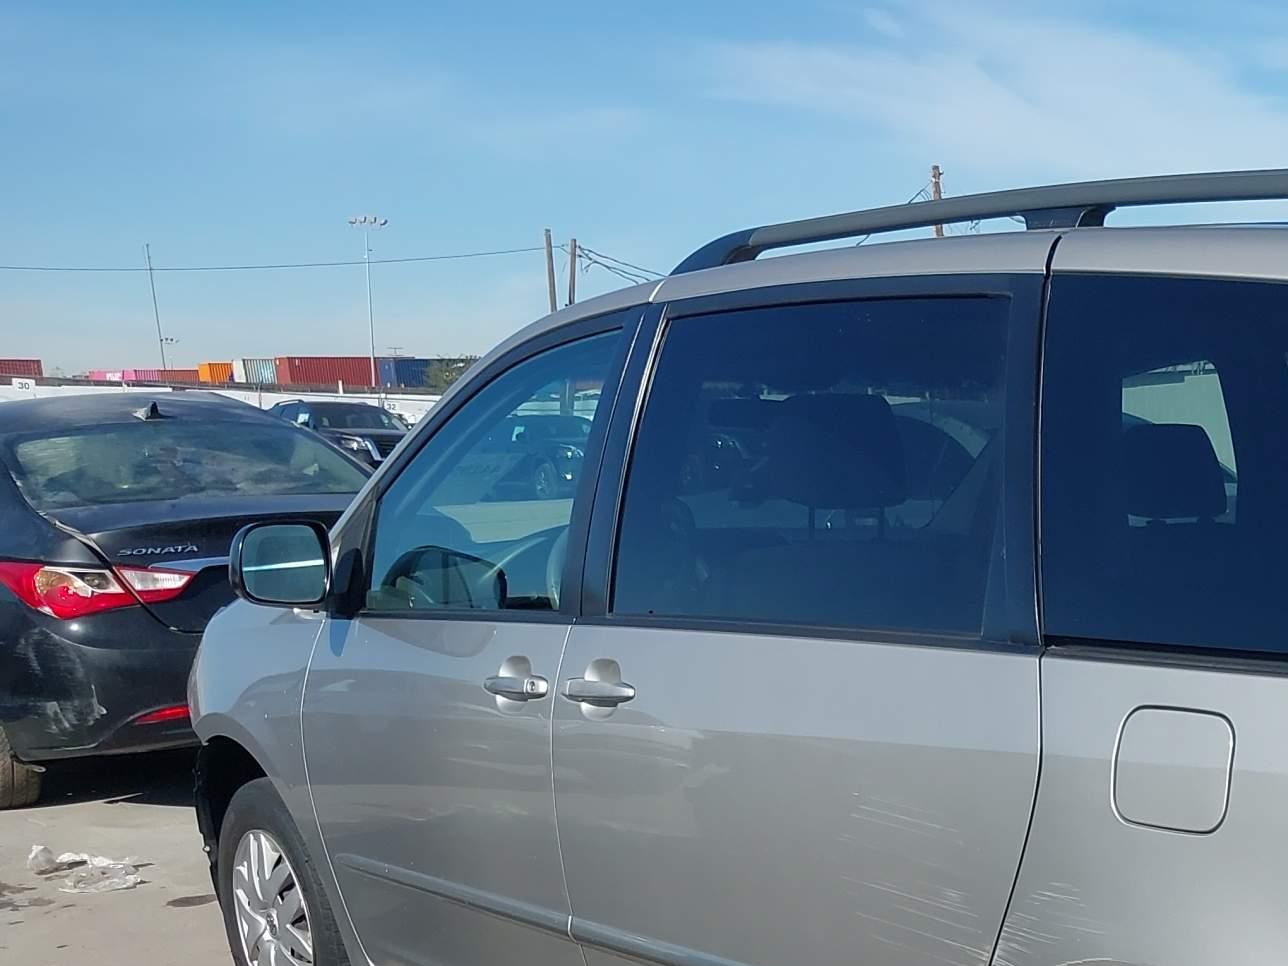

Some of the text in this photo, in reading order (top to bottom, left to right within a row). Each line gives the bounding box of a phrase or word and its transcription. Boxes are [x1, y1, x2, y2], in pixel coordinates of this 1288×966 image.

[18, 382, 30, 390] 30
[387, 403, 397, 411] 32
[117, 545, 198, 556] SONATA
